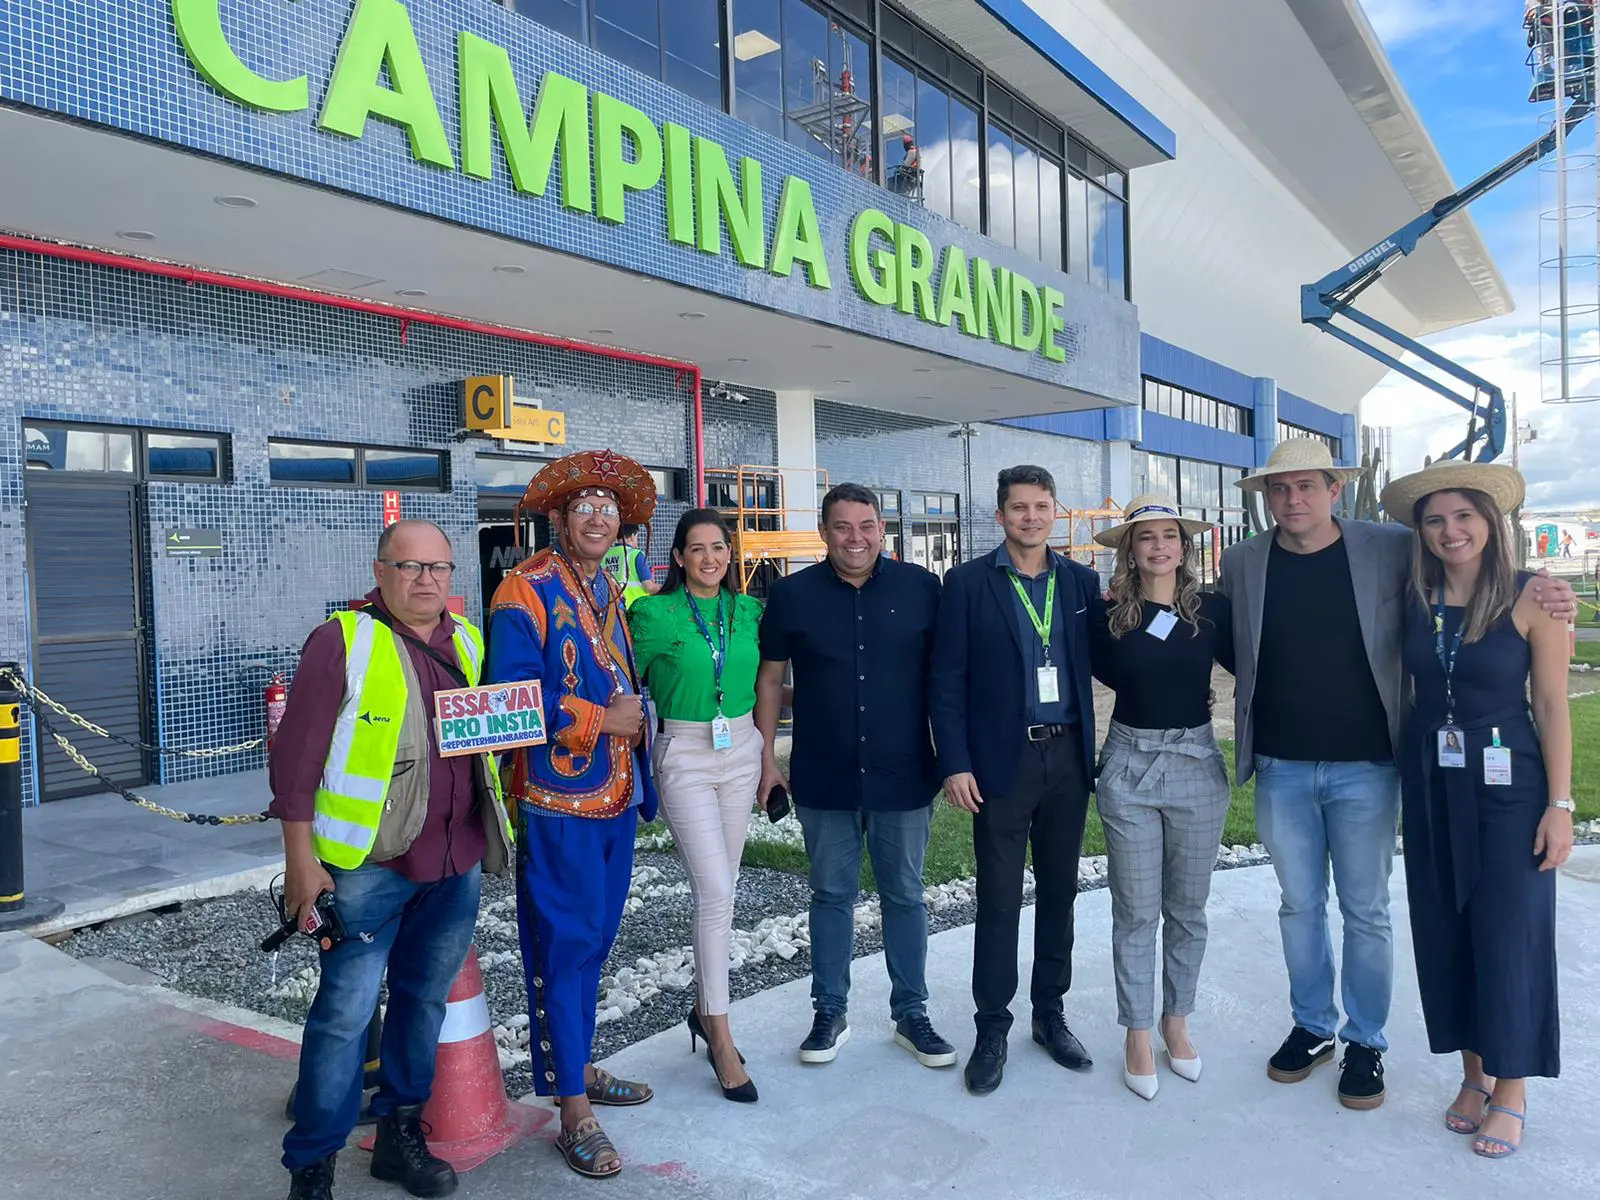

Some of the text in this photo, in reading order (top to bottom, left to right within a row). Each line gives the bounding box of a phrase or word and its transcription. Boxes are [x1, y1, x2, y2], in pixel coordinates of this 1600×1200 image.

[172, 0, 1066, 363] CAMPINA GRANDE
[1348, 239, 1396, 273] ORGUEL
[472, 384, 495, 420] C
[548, 417, 561, 438] C
[386, 493, 397, 508] H
[605, 556, 620, 565] NAV
[438, 686, 540, 720] ESSA VAI
[440, 729, 544, 750] @REPORTERHIRANBARBOSA
[441, 709, 542, 740] PRO INSTA
